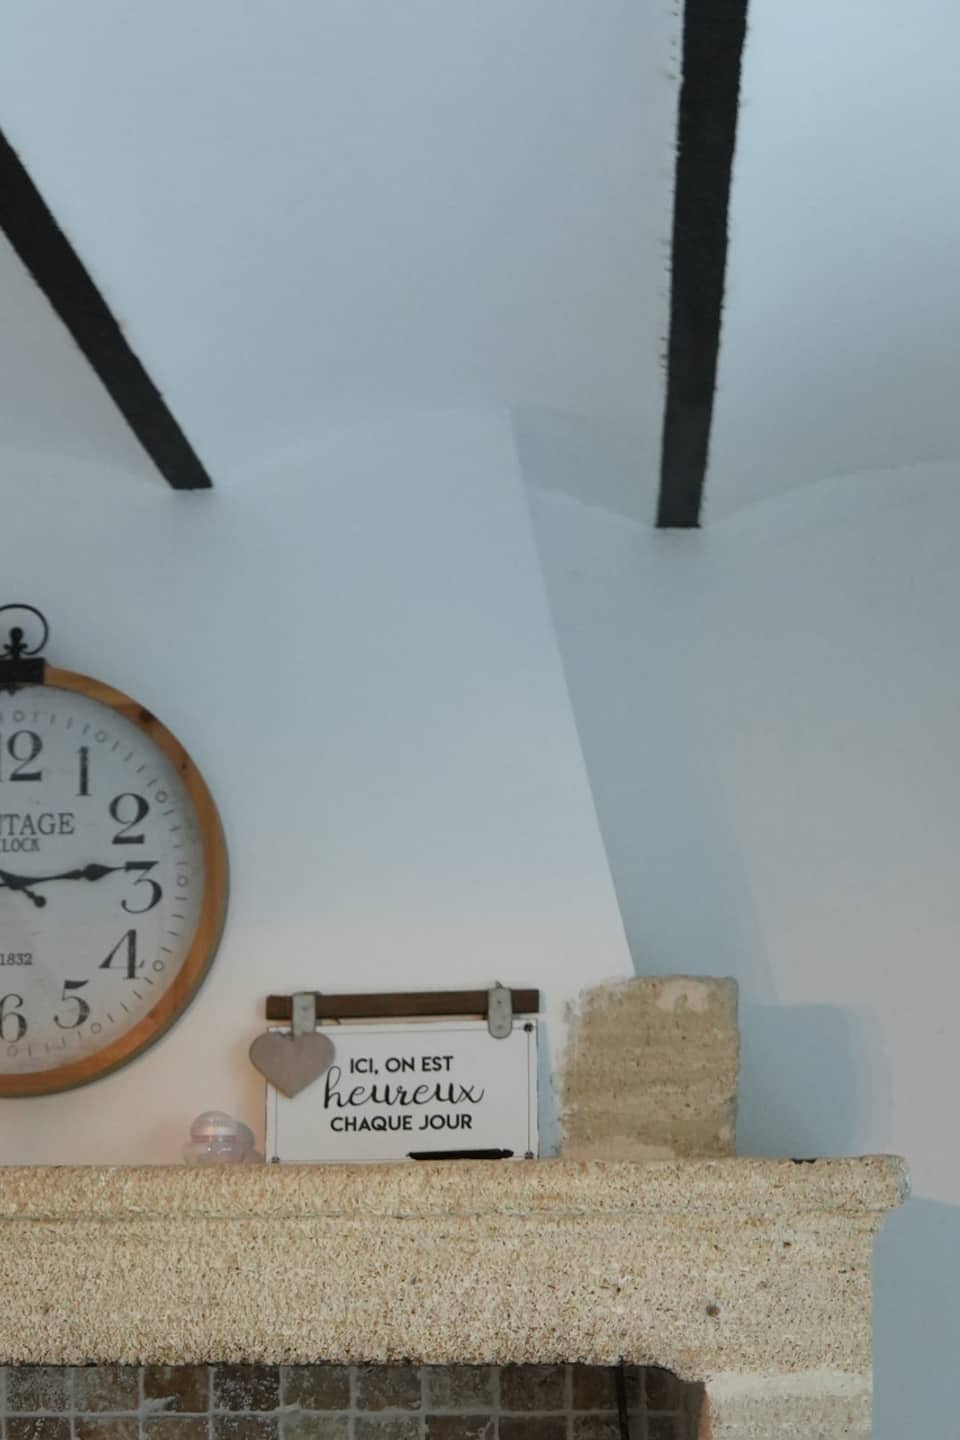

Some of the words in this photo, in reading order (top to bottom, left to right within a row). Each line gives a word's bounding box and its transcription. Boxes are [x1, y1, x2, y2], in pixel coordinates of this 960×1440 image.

[75, 745, 93, 797] 1
[108, 792, 151, 845] 2
[120, 860, 163, 915] 3
[0, 952, 33, 967] 1832
[98, 928, 145, 981] 4
[53, 979, 92, 1030] 5
[323, 1065, 485, 1110] heureux
[350, 1057, 379, 1075] ICI,
[385, 1057, 415, 1072] ON
[421, 1056, 454, 1072] EST
[330, 1115, 413, 1132] CHAQUE
[418, 1114, 473, 1131] JOUR
